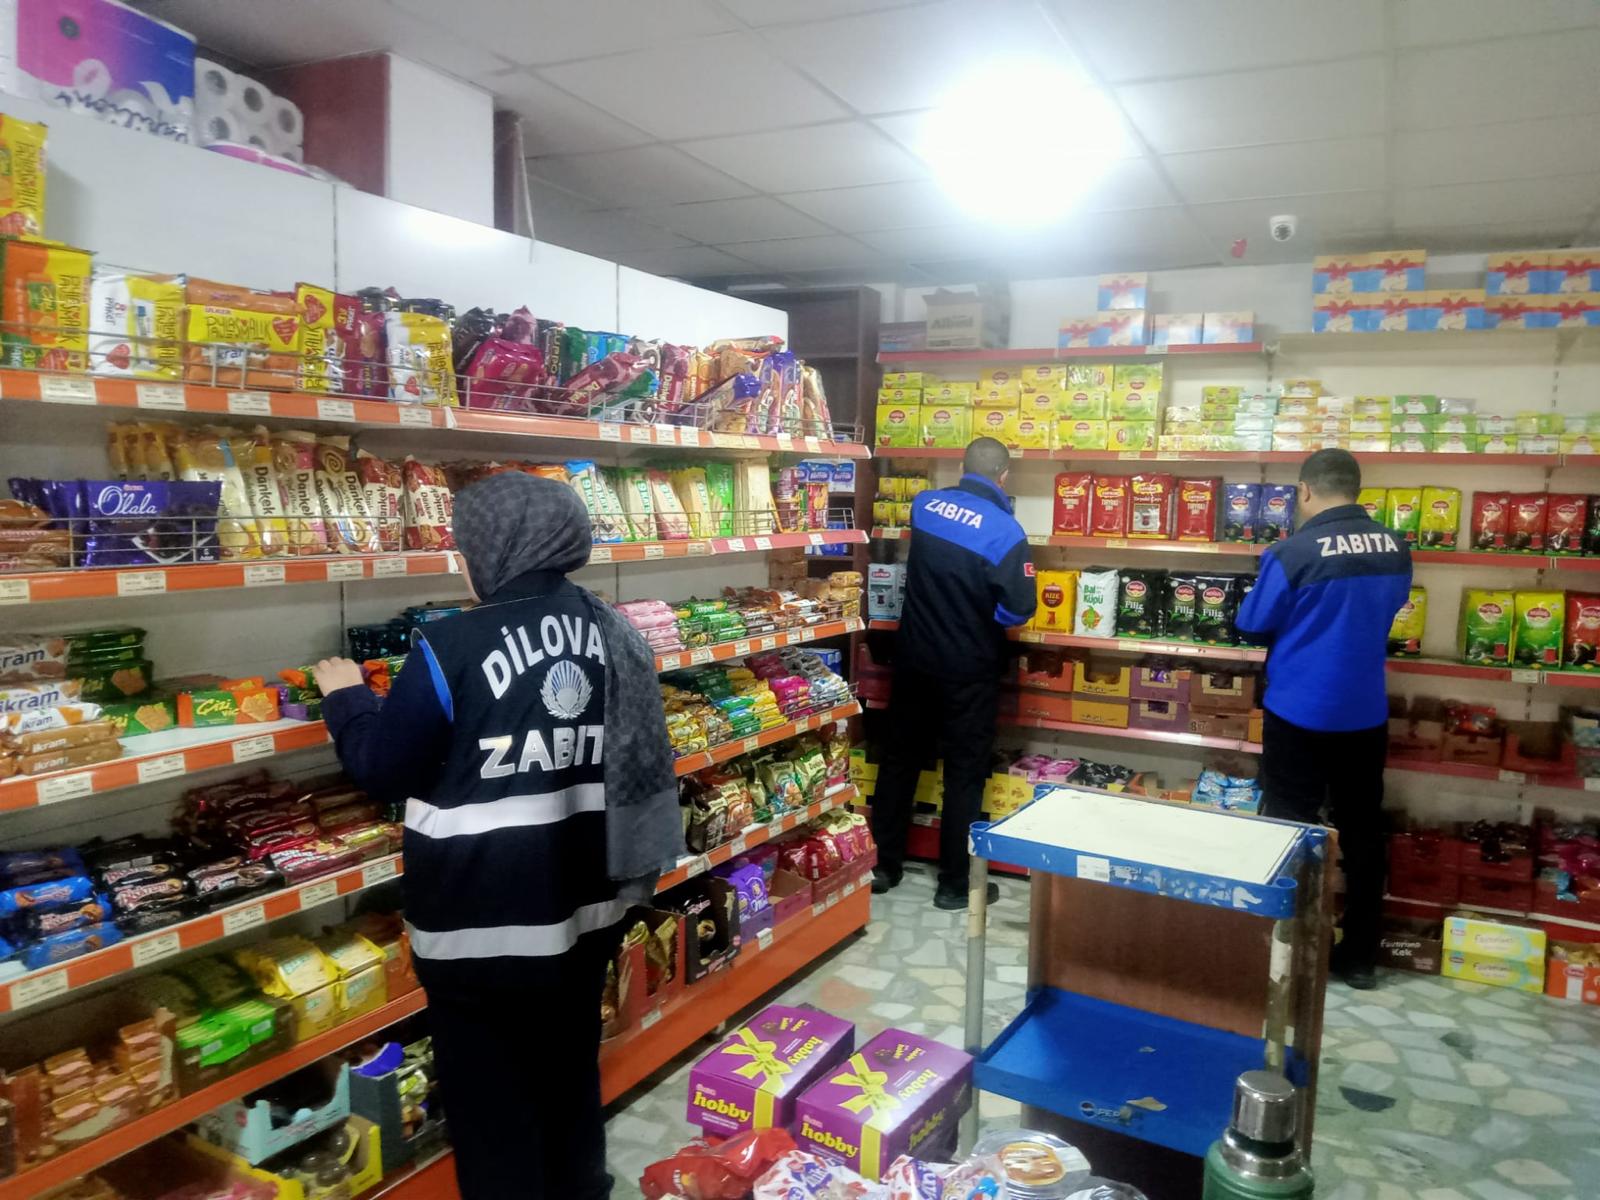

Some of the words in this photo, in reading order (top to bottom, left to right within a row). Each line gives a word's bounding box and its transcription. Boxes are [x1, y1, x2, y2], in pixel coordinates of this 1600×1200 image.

[254, 466, 276, 515] Dankek
[924, 499, 984, 528] ZABITA
[1316, 533, 1398, 557] ZABITA
[693, 1091, 752, 1123] hobby
[800, 1122, 858, 1158] hobby
